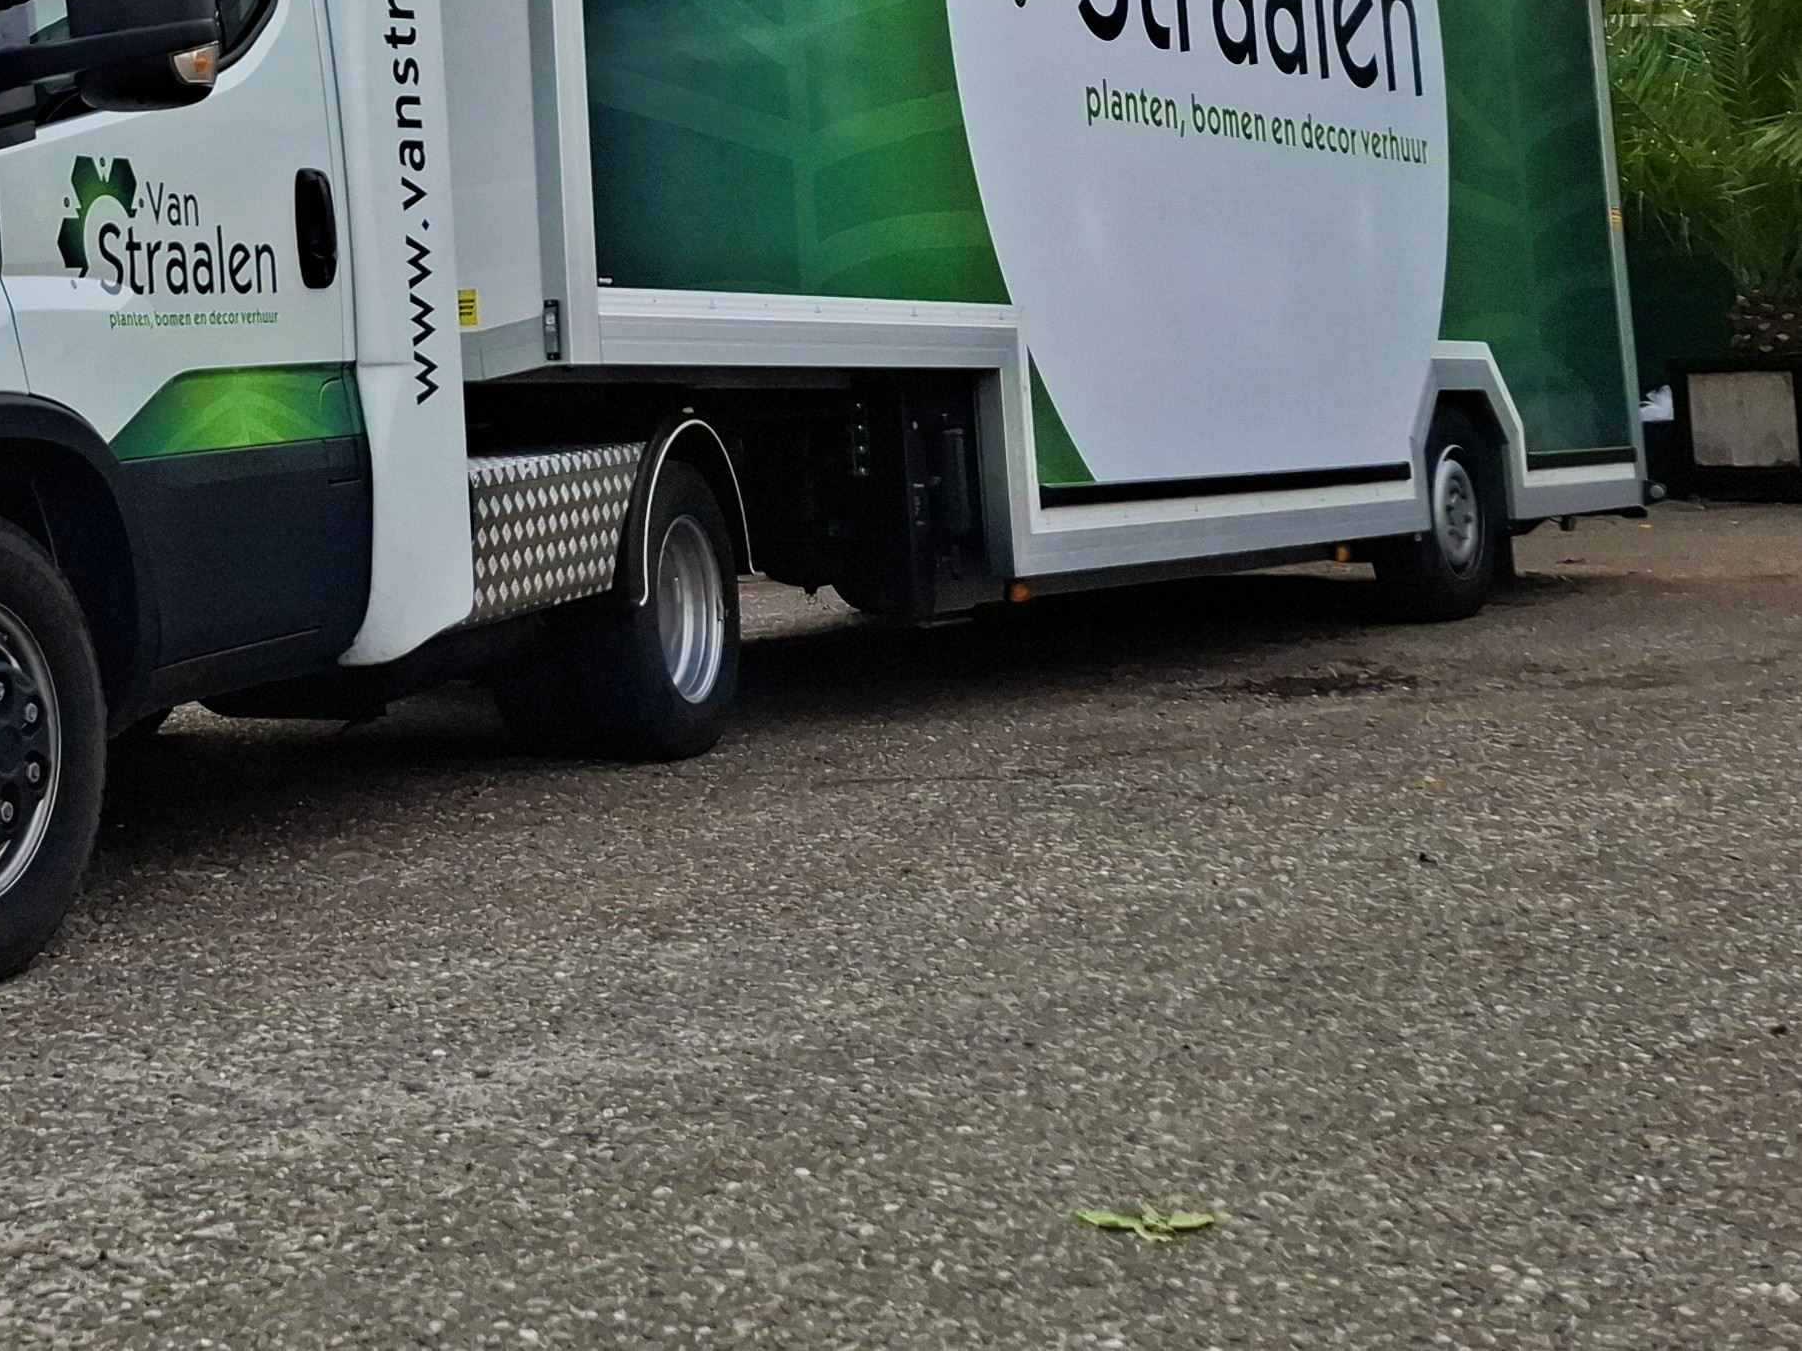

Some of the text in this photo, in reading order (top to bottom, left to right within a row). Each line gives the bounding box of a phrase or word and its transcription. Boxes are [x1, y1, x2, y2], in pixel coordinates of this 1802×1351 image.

[1086, 78, 1428, 164] planten, bomen en decor verhuur
[146, 181, 199, 227] Van
[98, 222, 278, 295] Straalen
[109, 308, 279, 330] planten, bomen en decor verhuur
